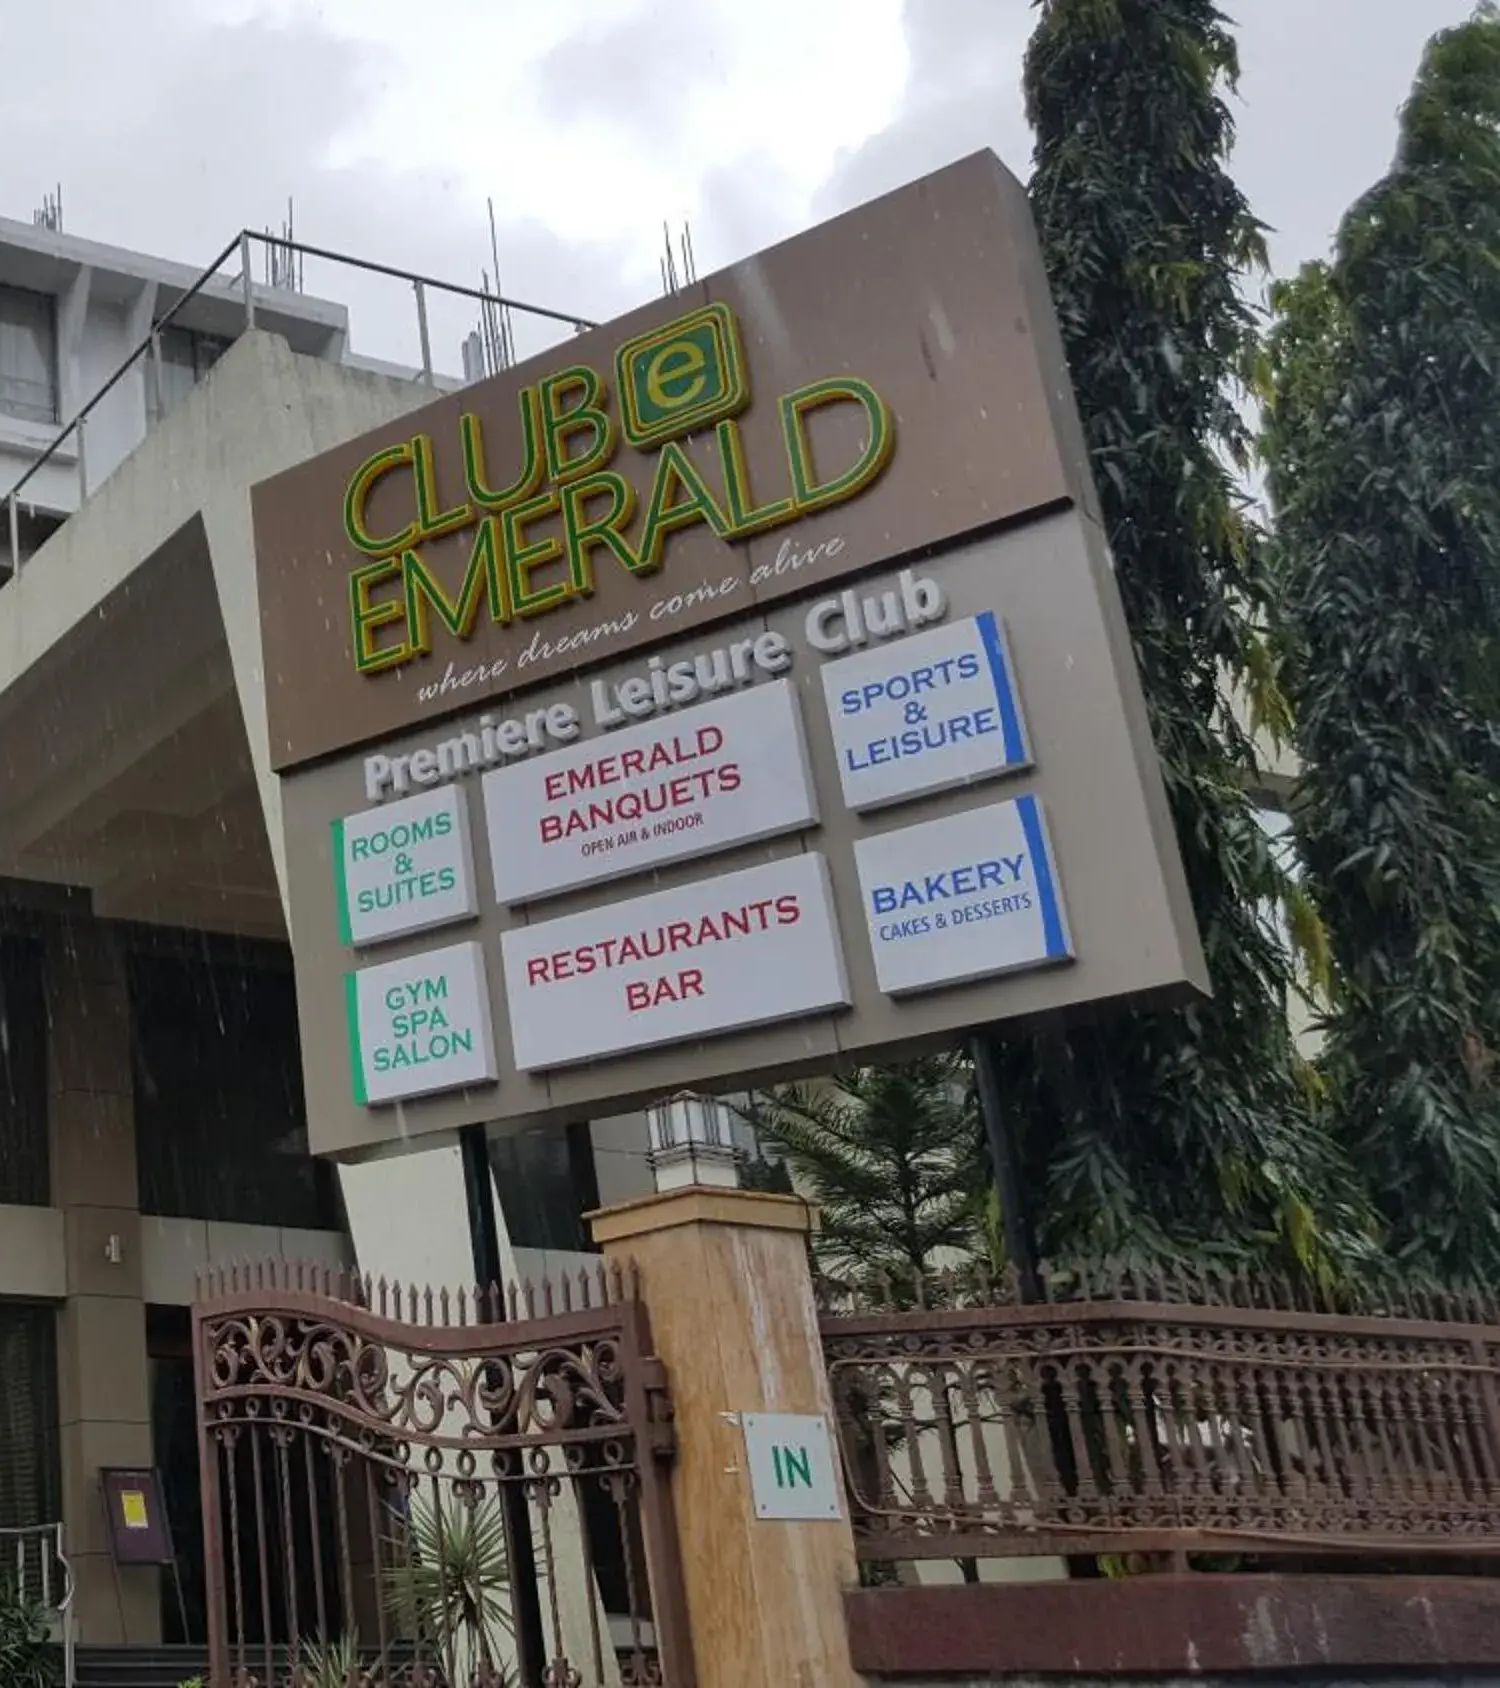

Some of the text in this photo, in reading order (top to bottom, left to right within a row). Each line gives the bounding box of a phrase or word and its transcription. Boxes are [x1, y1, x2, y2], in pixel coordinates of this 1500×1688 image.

[343, 365, 617, 557] CLUB
[349, 377, 894, 674] EMERALD
[416, 533, 847, 704] where dreams come alive
[364, 568, 948, 804] Premiere Leisure Club
[841, 652, 982, 716] SPORTS
[904, 701, 928, 723] &
[544, 726, 724, 801] EMERALD
[846, 707, 999, 773] LEISURE
[539, 763, 741, 843] BANQUETS
[351, 811, 453, 863] ROOMS
[581, 812, 704, 857] OPEN AIR & INDOOR
[357, 866, 457, 914] SUITES
[394, 852, 415, 876] &
[872, 853, 1025, 915] BAKERY
[526, 894, 801, 988] RESTAURANTS
[879, 891, 1032, 941] CAKES & DESSERTS
[385, 974, 449, 1012] GYM
[625, 968, 706, 1013] BAR
[391, 1009, 450, 1039] SPA
[372, 1028, 474, 1073] SALON
[771, 1445, 813, 1489] IN
